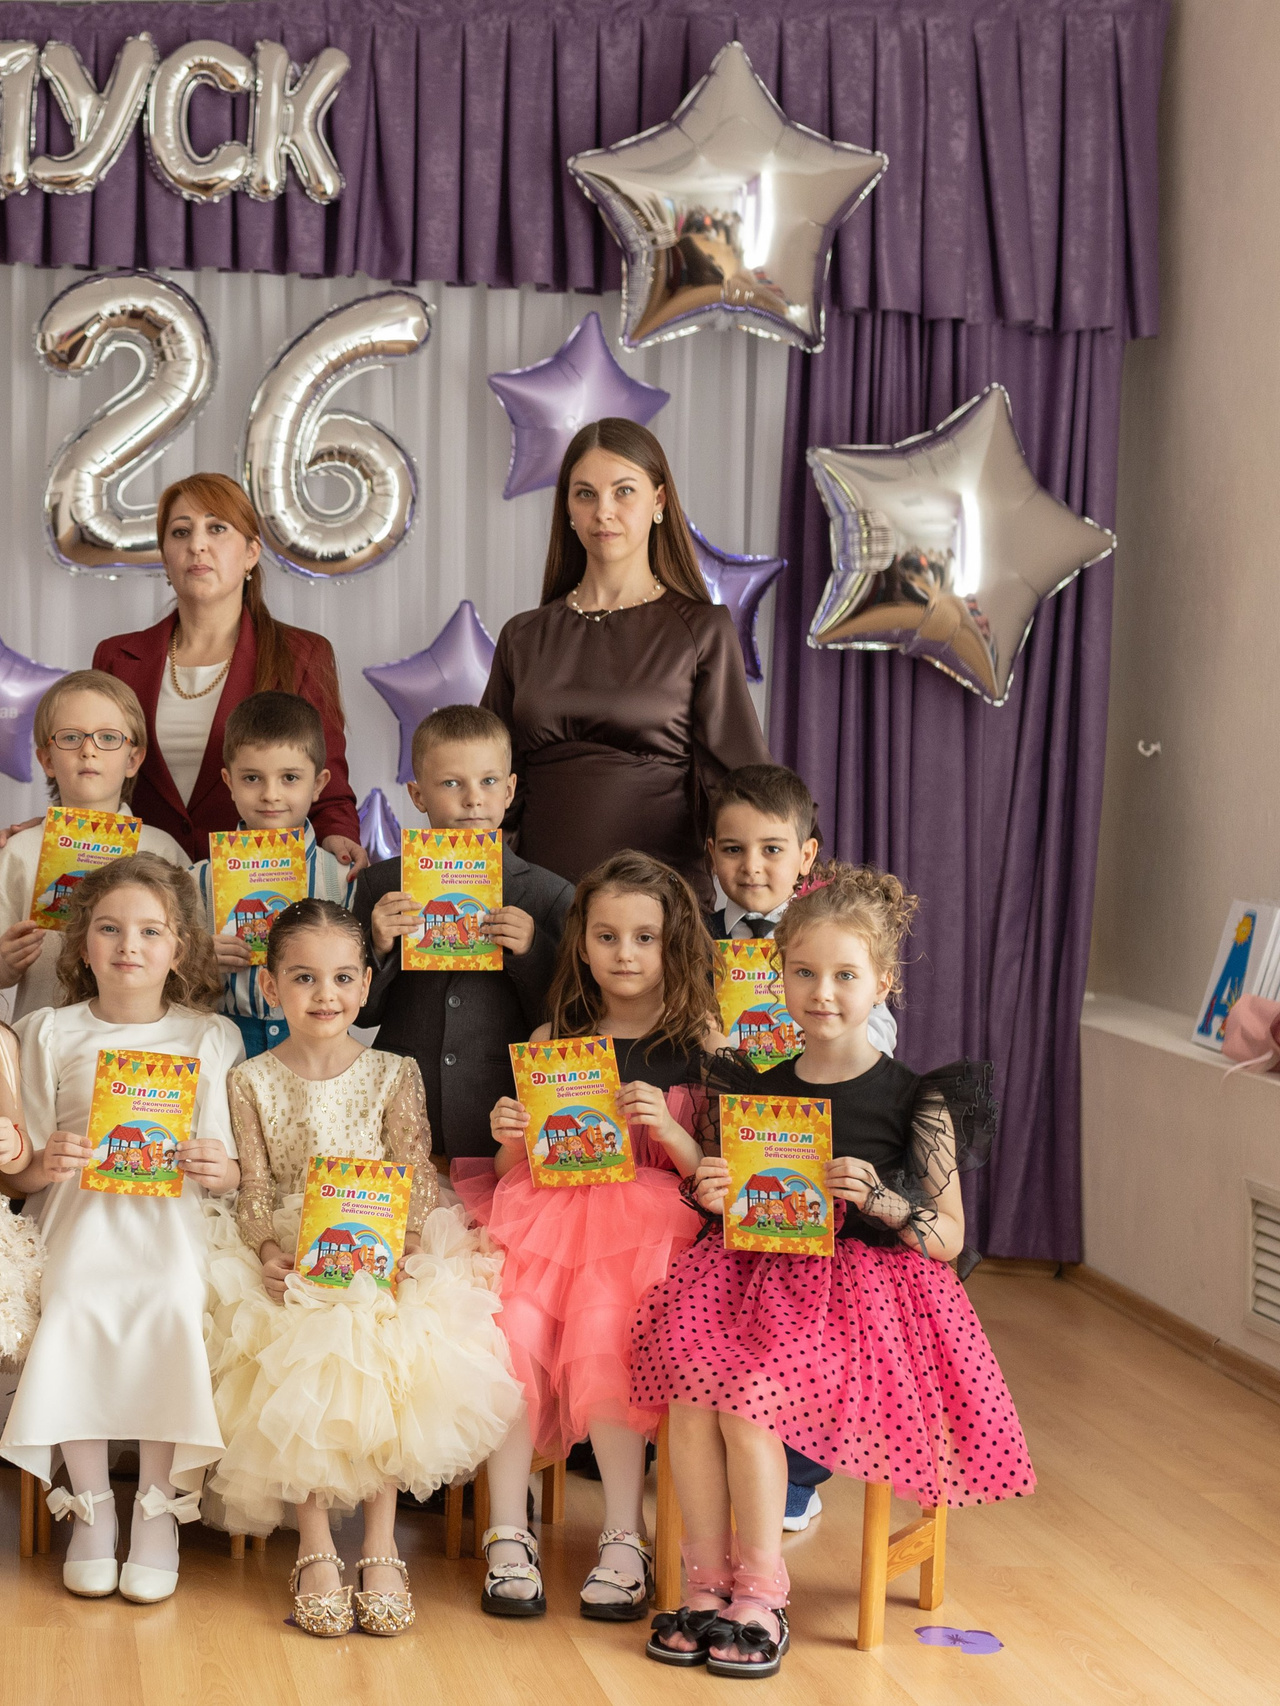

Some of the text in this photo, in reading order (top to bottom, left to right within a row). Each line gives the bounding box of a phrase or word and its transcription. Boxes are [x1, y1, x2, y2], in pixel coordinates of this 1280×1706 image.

[59, 837, 122, 854] Диплом
[228, 858, 290, 870] Диплом
[419, 857, 486, 870] Диплом
[731, 969, 784, 981] Дипл
[531, 1070, 600, 1084] Диплом
[112, 1082, 179, 1099] Диплом
[740, 1128, 812, 1143] Диплом
[321, 1185, 390, 1203] Диплом
